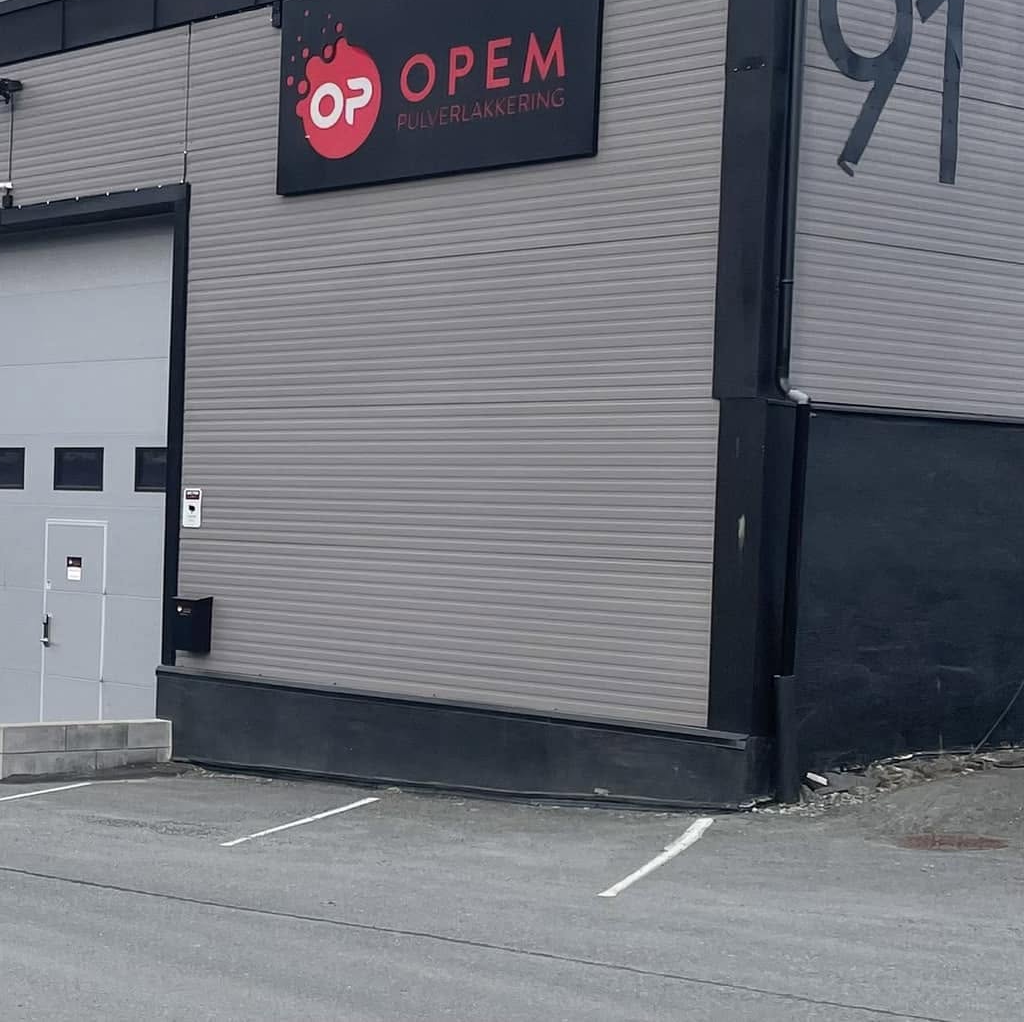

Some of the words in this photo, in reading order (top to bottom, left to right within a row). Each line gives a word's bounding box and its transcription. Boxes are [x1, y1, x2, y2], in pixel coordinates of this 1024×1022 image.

[400, 27, 566, 102] OPEM
[309, 76, 373, 129] OP
[397, 88, 566, 131] PULVERLAKKERING
